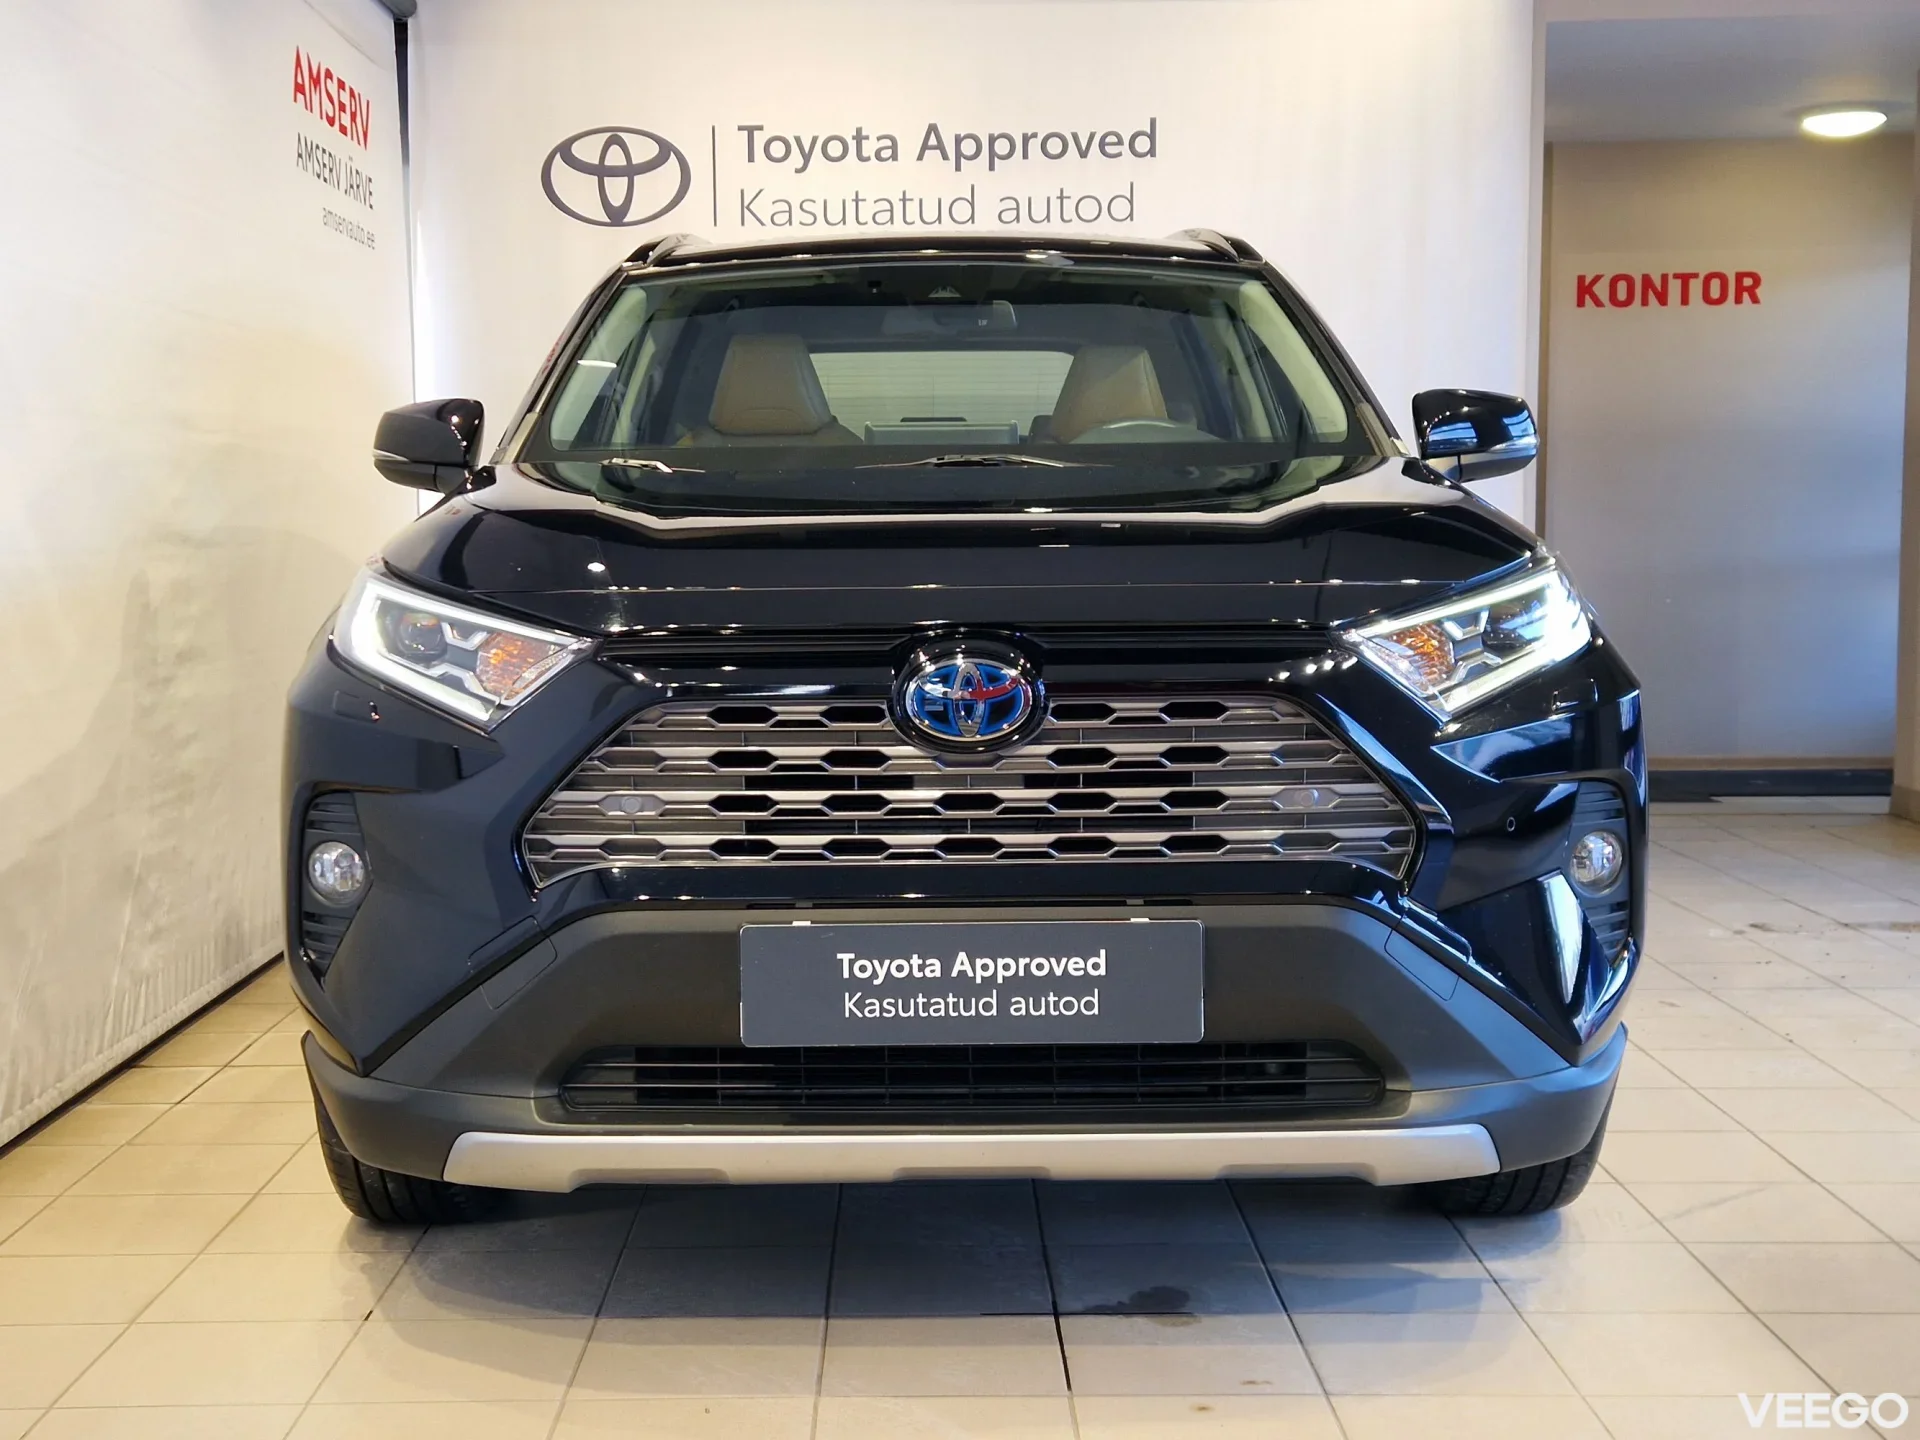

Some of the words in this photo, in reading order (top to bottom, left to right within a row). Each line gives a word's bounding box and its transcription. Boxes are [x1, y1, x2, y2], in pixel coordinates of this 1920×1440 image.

[293, 45, 370, 151] AMSERV
[737, 124, 899, 174] Toyota
[916, 117, 1158, 171] Approved
[296, 131, 342, 192] AMSERV
[344, 155, 374, 210] JÄRVE
[739, 183, 976, 227] Kasutatud
[997, 181, 1135, 225] autod
[321, 206, 376, 250] amservauto.ee
[1576, 271, 1762, 308] KONTOR
[836, 952, 942, 986] Toyota
[950, 948, 1107, 984] Approved
[844, 988, 998, 1018] Kasutatud
[1009, 988, 1099, 1017] autod
